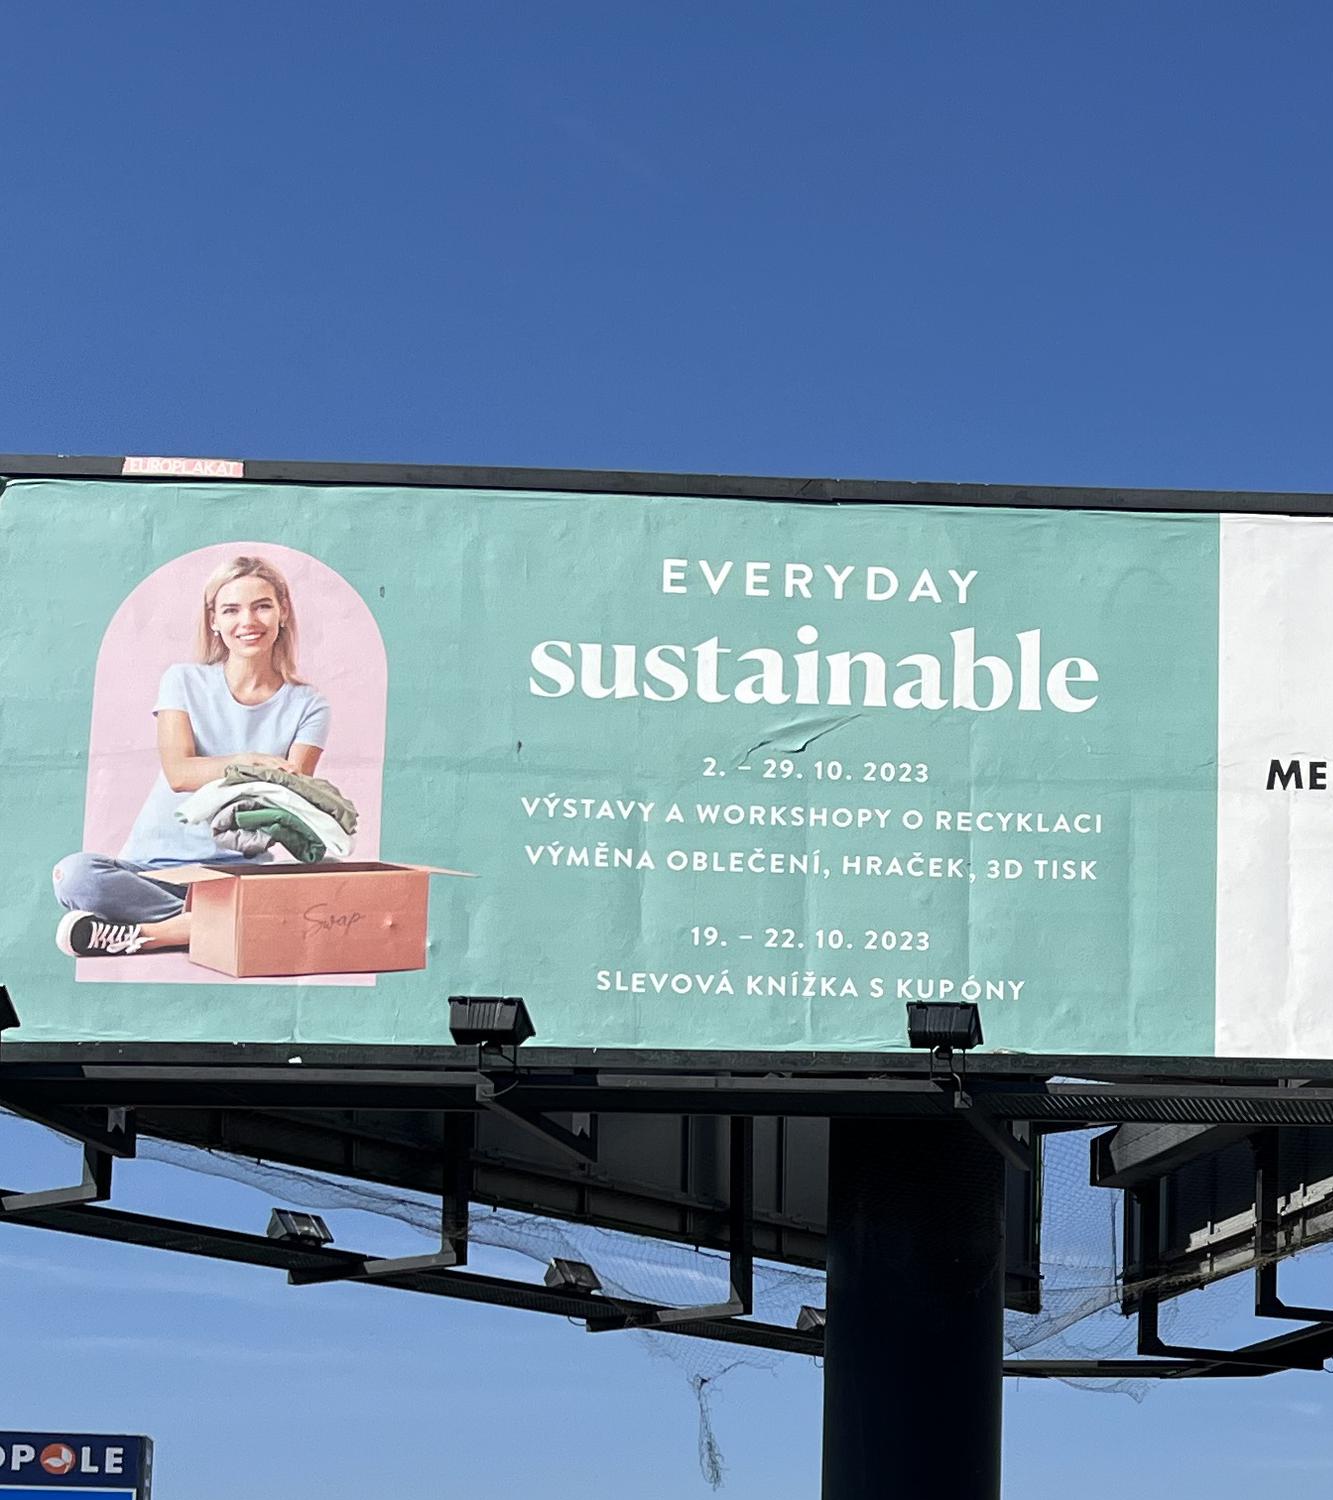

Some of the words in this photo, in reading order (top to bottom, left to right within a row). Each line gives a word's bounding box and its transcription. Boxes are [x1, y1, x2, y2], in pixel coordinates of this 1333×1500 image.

[130, 458, 237, 476] EUROPLAKAT
[662, 558, 978, 604] EVERYDAY
[529, 624, 1099, 713] sustainable
[702, 757, 725, 777] 2.
[763, 759, 803, 779] 29.
[814, 760, 852, 781] 10.
[863, 761, 929, 783] 2023
[521, 792, 655, 822] VÝSTAVY
[665, 803, 684, 823] A
[696, 804, 891, 829] WORKSHOPY
[902, 809, 923, 831] O
[936, 810, 1102, 834] RECYKLACI
[525, 840, 655, 870] VÝMĚNA
[666, 847, 831, 879] OBLEČENÍ,
[842, 852, 976, 884] HRAČEK,
[987, 859, 1023, 880] 3D
[1034, 860, 1098, 881] TISK
[691, 926, 727, 947] 19.
[765, 927, 804, 949] 22.
[815, 929, 853, 950] 10.
[864, 930, 930, 951] 2023
[597, 969, 734, 995] SLEVOVÁ
[746, 971, 859, 1000] KNÍŽKA
[869, 977, 884, 998] S
[897, 974, 1025, 1003] KUPÓNY
[0, 1443, 124, 1474] POLE
